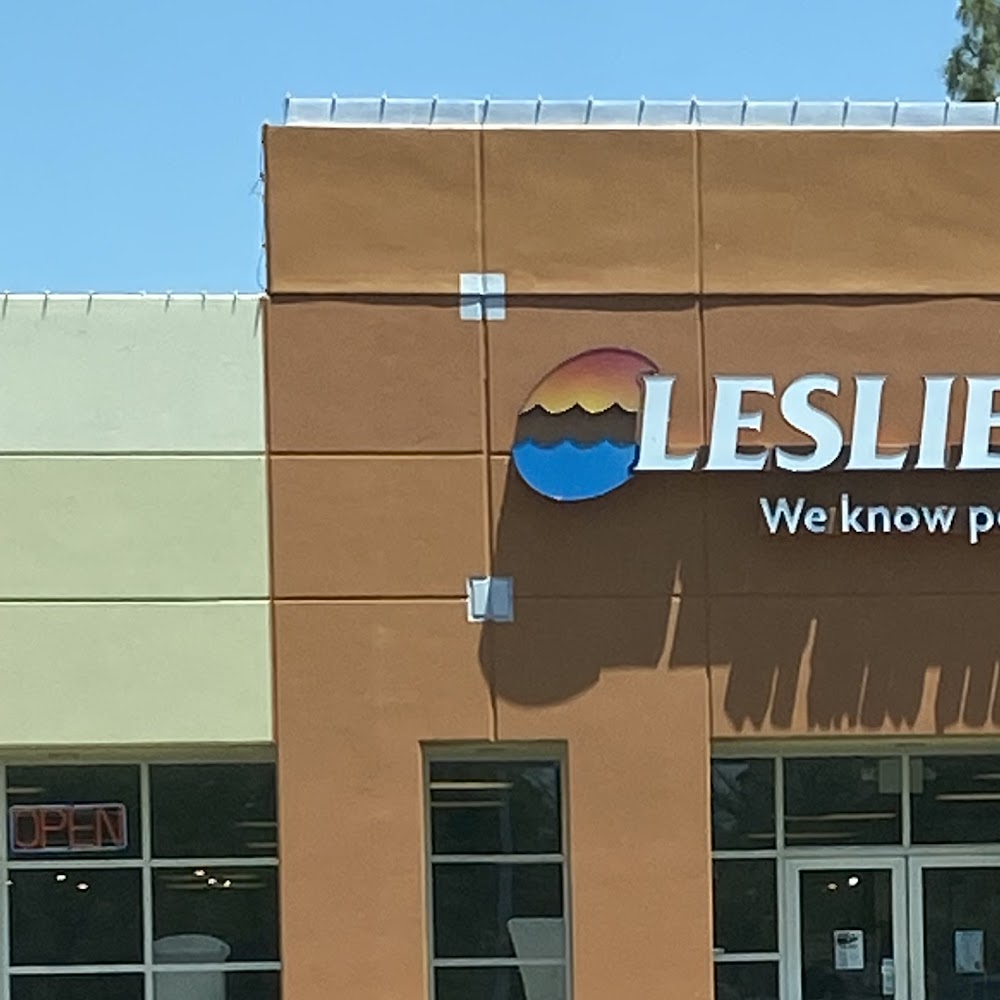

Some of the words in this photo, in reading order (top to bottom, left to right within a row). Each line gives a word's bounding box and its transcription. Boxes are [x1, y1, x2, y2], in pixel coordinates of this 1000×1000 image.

[760, 497, 827, 534] We
[841, 493, 956, 533] know
[14, 807, 124, 849] OPEN
